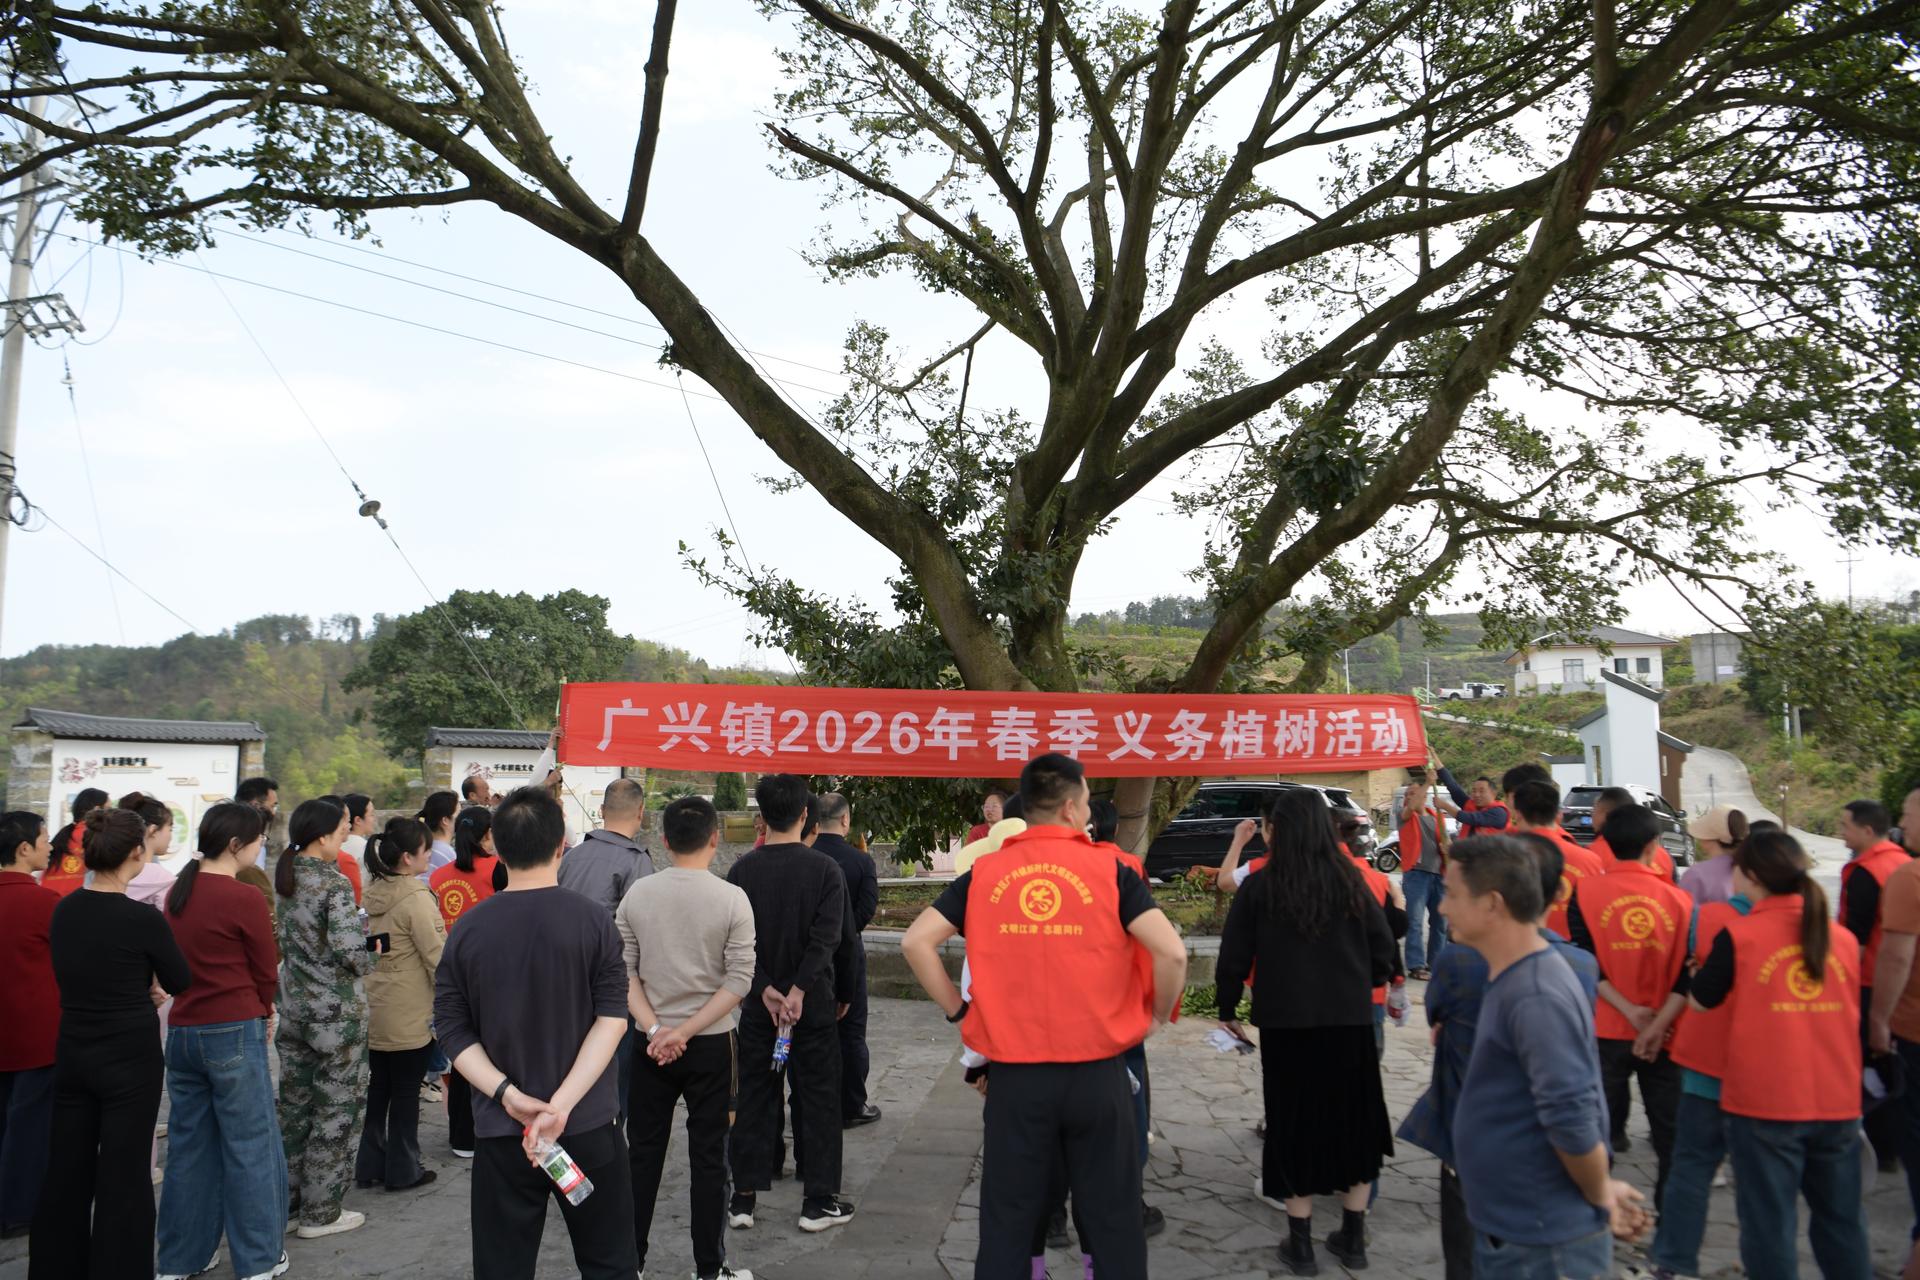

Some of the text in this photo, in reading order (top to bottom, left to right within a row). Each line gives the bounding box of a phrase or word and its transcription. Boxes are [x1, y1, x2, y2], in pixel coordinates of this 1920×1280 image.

[596, 698, 1410, 762] 广兴镇2026年春季义务植树活动
